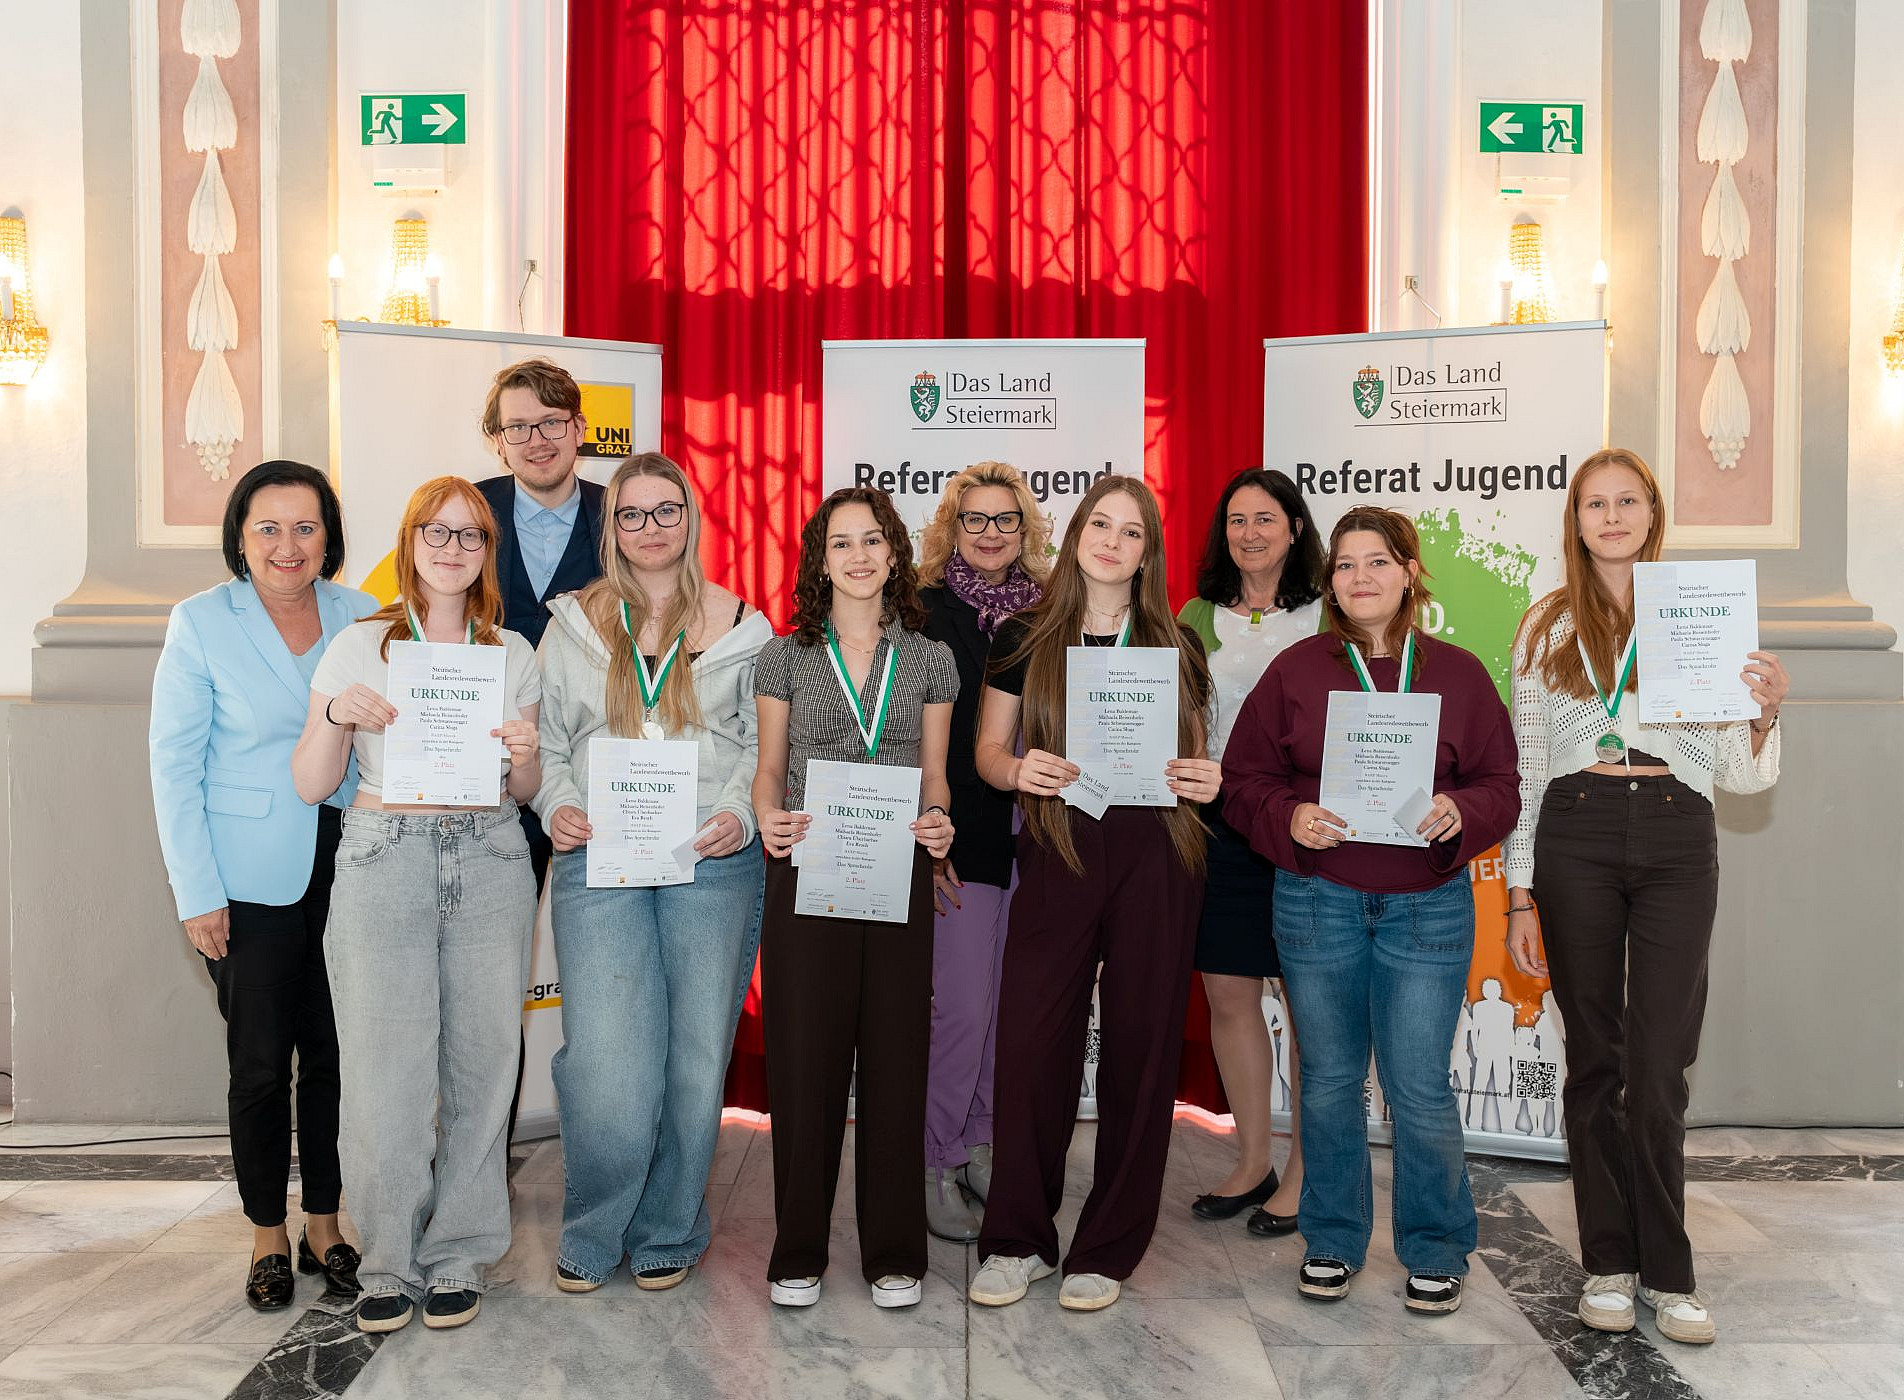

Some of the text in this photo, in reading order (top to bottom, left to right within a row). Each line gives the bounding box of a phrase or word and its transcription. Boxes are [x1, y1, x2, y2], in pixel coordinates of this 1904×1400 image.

[953, 372, 1051, 393] Das Land
[1396, 361, 1501, 387] Das Land
[946, 405, 1052, 424] Steiermark
[1390, 396, 1502, 420] Steiermark
[596, 427, 629, 443] UNI
[596, 444, 630, 455] GRAZ
[854, 461, 973, 494] Refer
[1296, 454, 1567, 501] Referat Jugend
[1659, 606, 1731, 619] URKUNDE
[411, 689, 480, 700] URKUNDE
[1089, 692, 1155, 702] URKUNDE
[1347, 733, 1412, 743] URKUNDE
[611, 782, 675, 792] URKUNDE
[1076, 780, 1103, 800] Steiermark
[1082, 772, 1094, 784] Das
[1095, 779, 1110, 792] Land
[827, 806, 895, 820] URKUNDE
